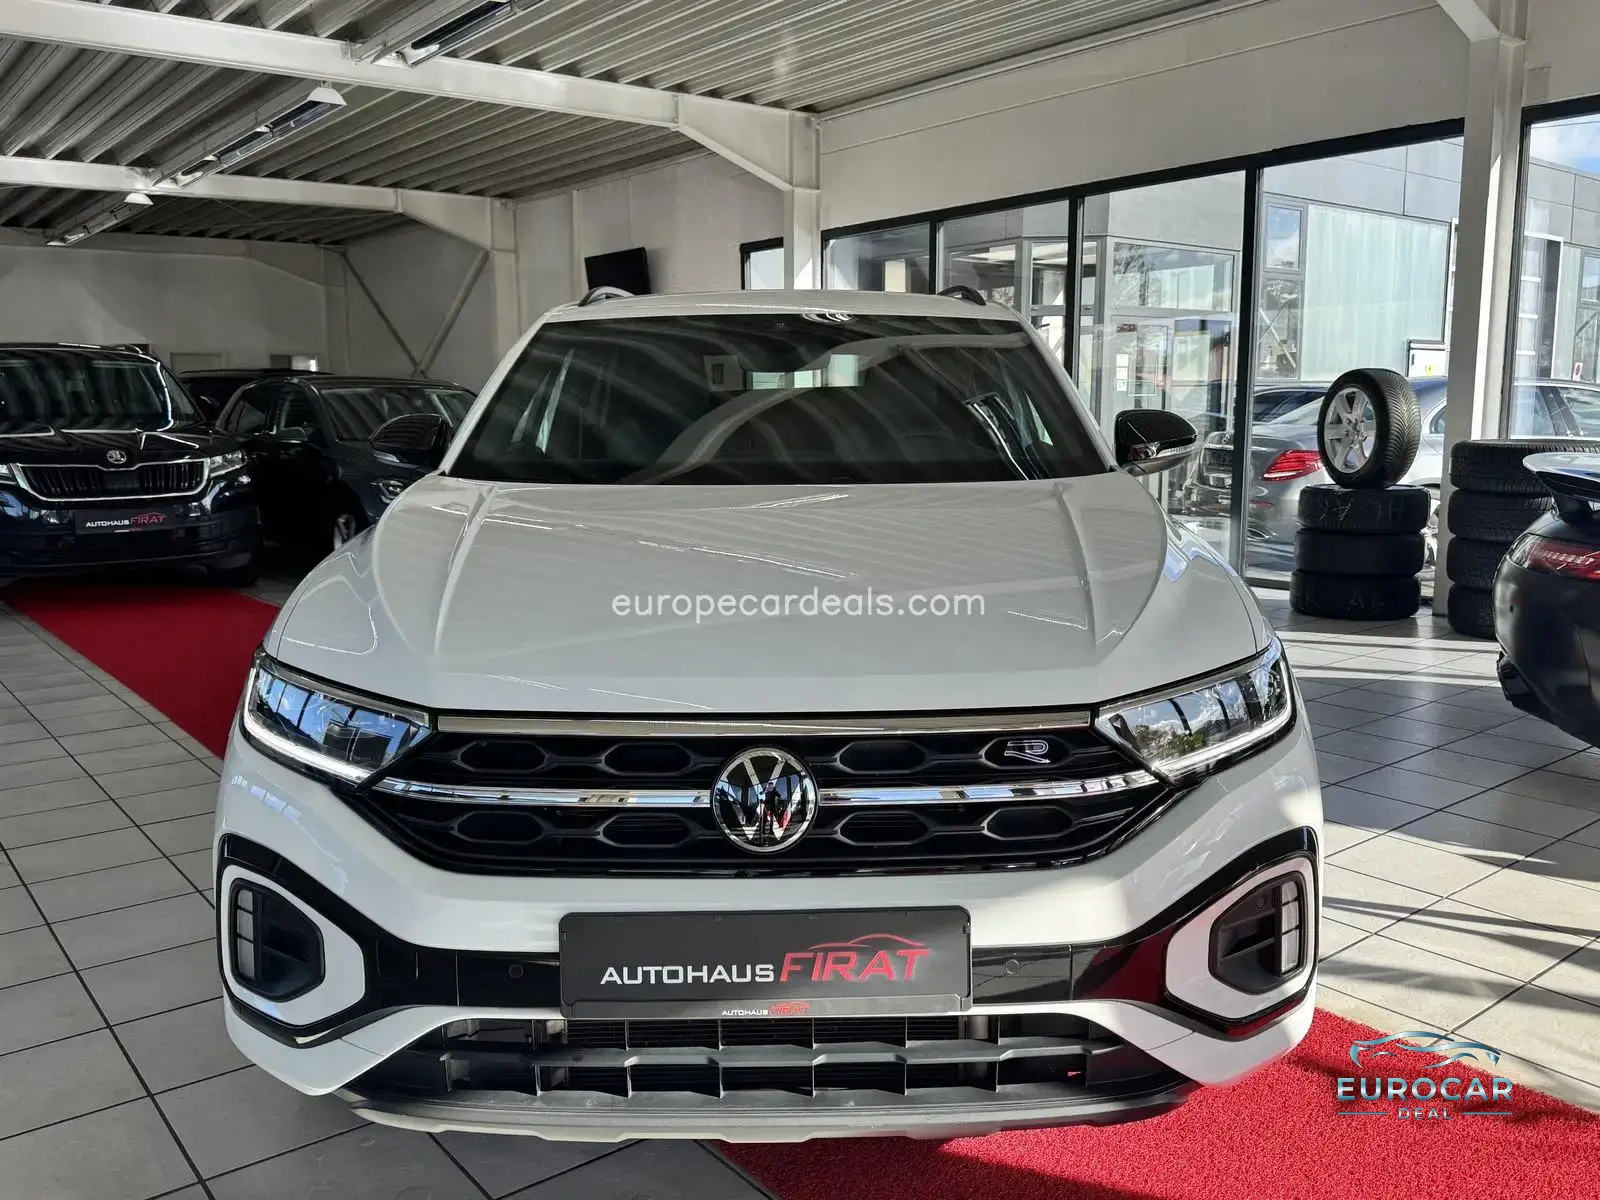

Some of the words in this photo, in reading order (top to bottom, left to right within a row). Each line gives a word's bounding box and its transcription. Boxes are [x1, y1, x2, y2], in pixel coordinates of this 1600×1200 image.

[85, 520, 130, 528] AUTOHAUS
[130, 515, 166, 525] FIRAT
[600, 964, 774, 985] AUTOHAUS
[779, 949, 931, 983] FIRAT
